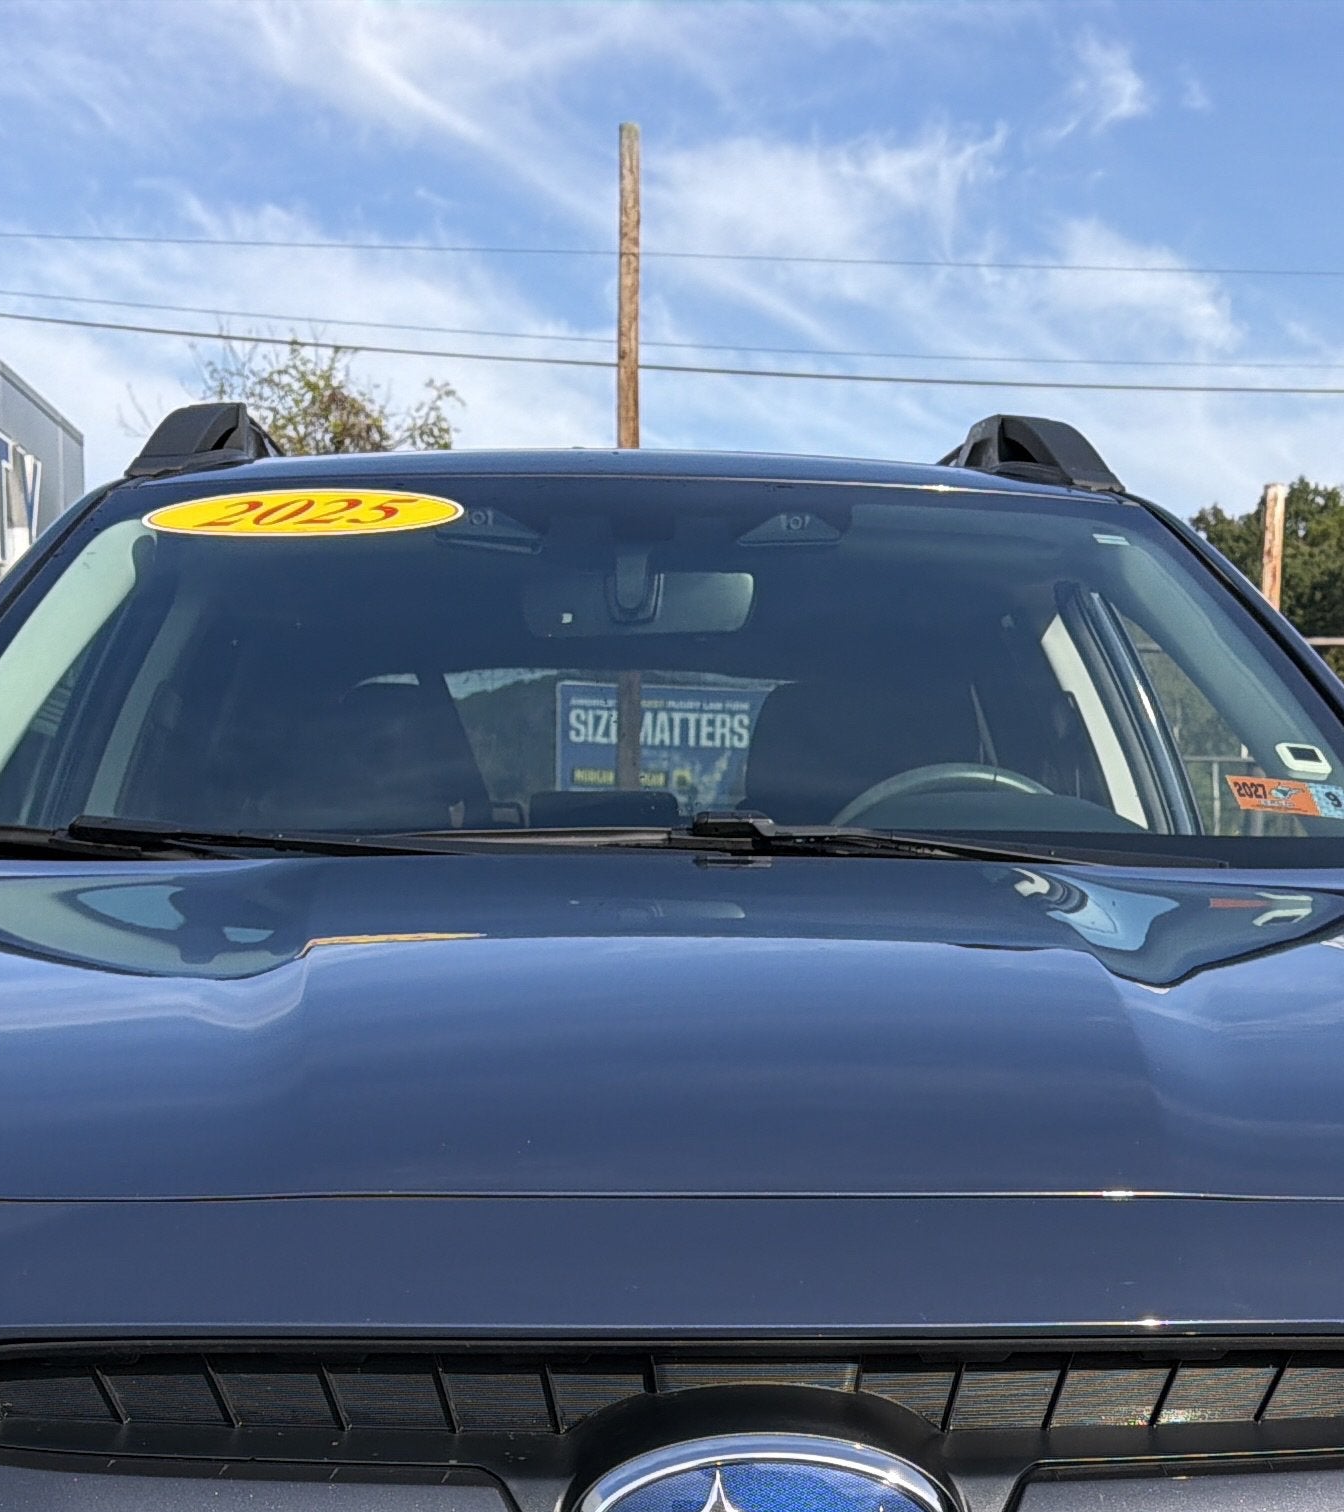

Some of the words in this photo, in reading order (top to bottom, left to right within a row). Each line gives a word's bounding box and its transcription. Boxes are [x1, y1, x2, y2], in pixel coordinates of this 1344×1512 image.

[193, 497, 419, 529] 2025
[1233, 781, 1268, 800] 2027
[1324, 791, 1343, 808] 9
